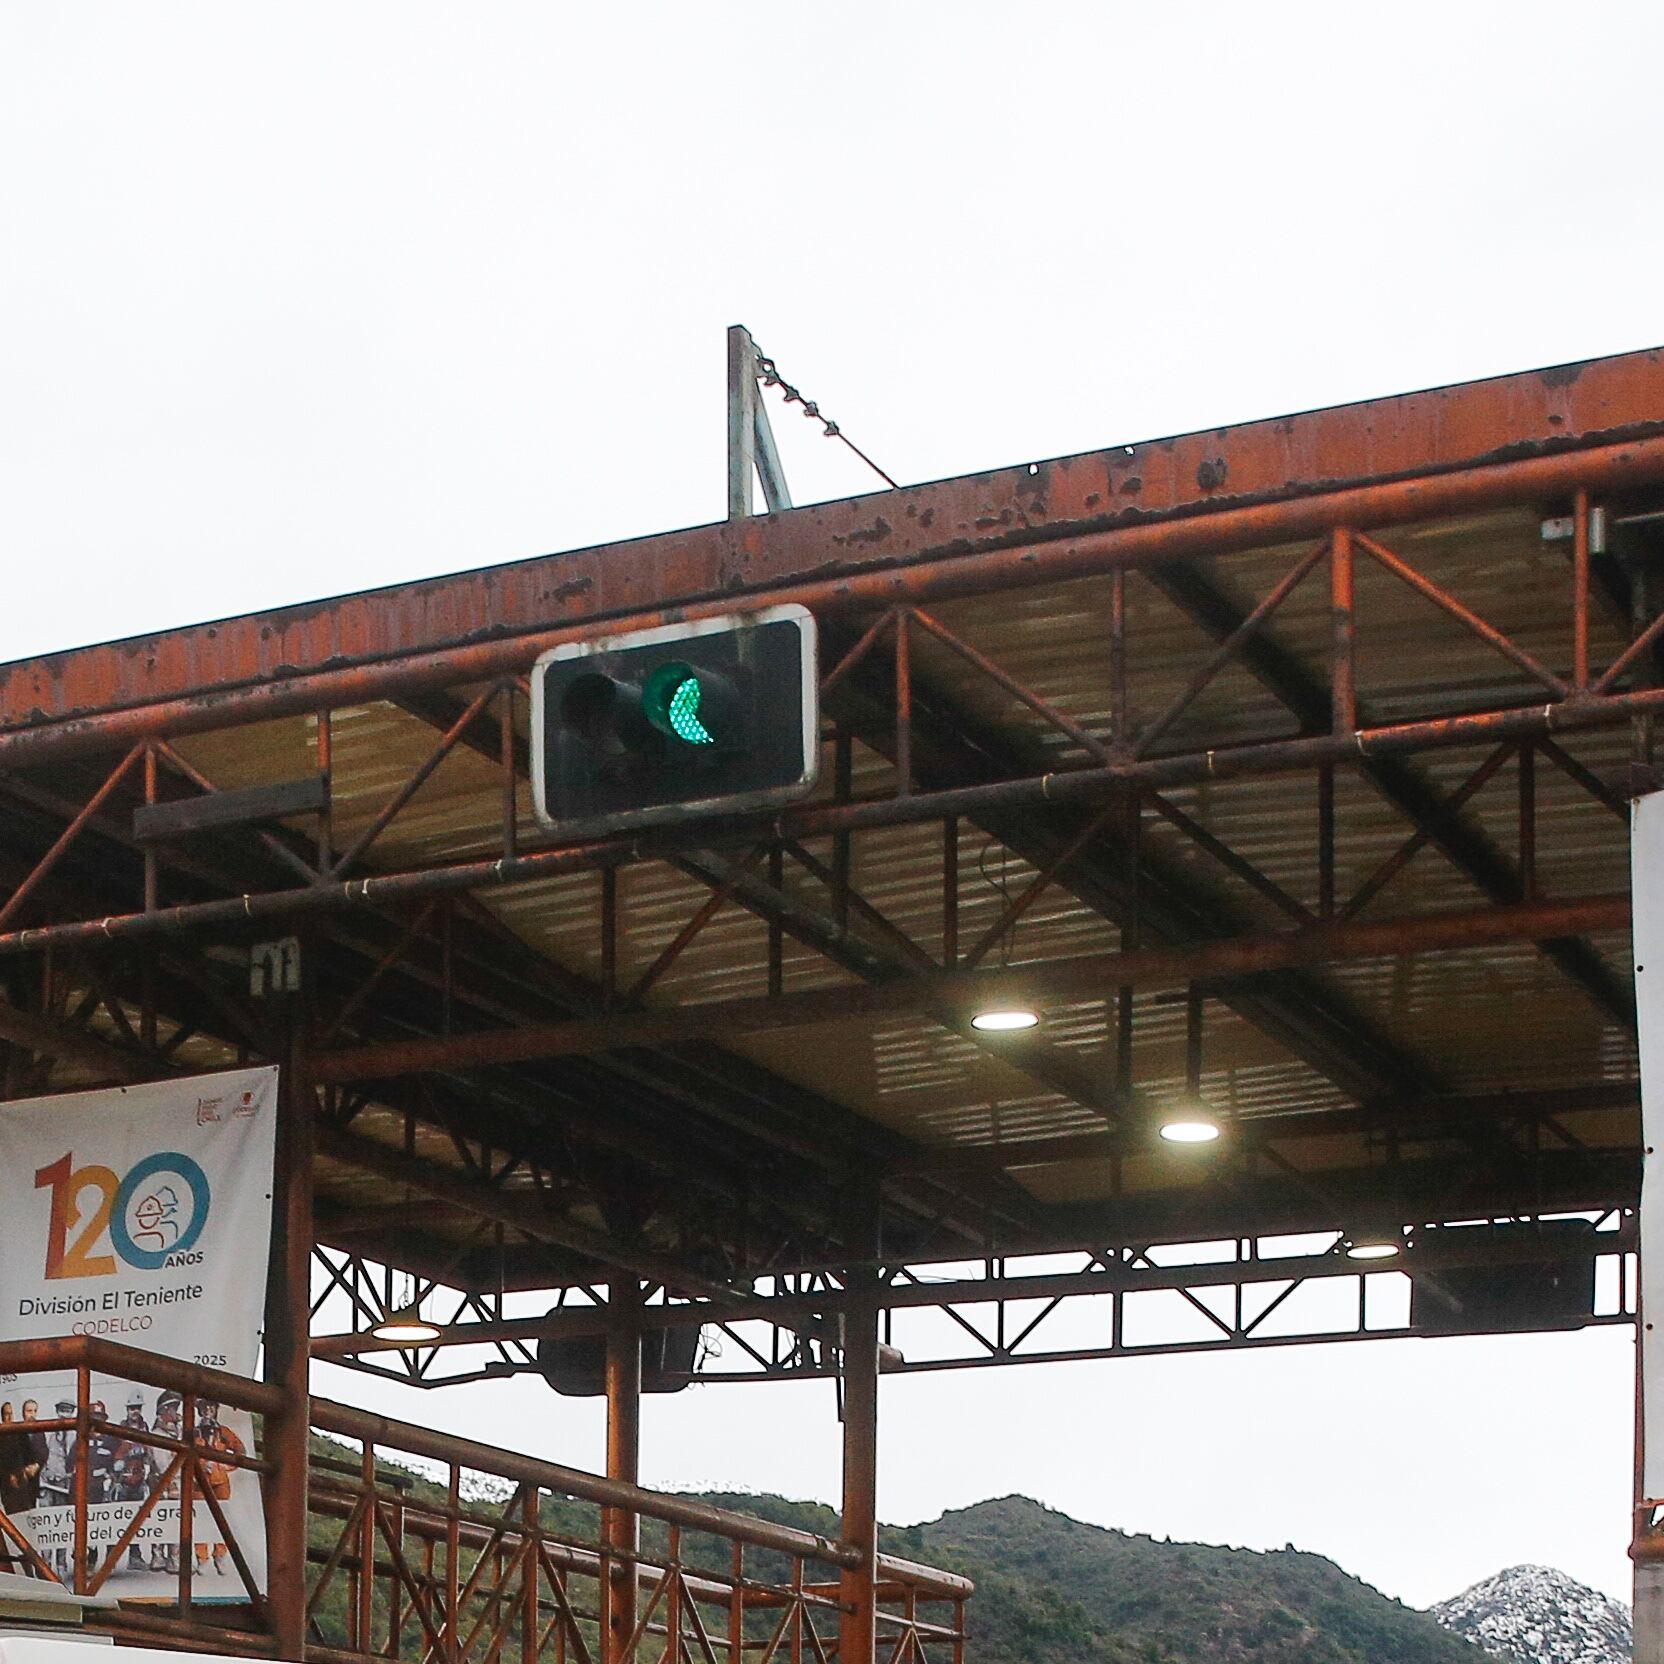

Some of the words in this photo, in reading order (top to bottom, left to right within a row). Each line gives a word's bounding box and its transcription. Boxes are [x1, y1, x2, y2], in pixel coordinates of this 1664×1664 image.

[35, 1152, 211, 1279] 120
[164, 1250, 204, 1269] AÑOS
[18, 1294, 96, 1316] División
[102, 1291, 119, 1310] El
[123, 1284, 203, 1308] Teniente
[71, 1315, 153, 1336] CODELCO
[54, 1513, 62, 1527] y
[114, 1506, 134, 1520] de
[89, 1526, 112, 1541] del
